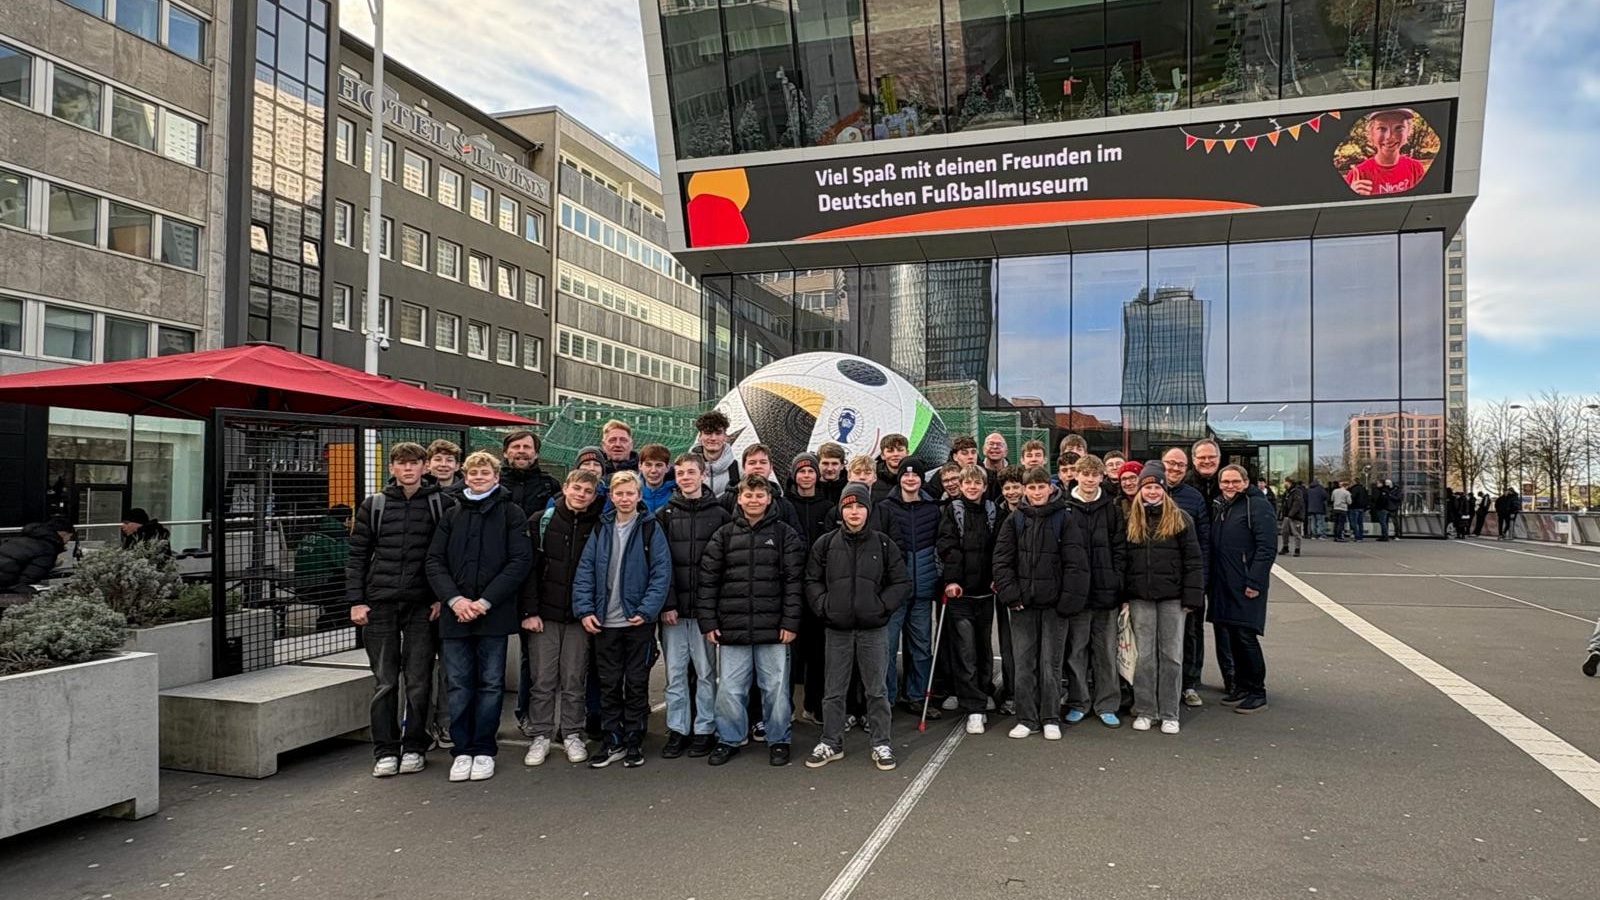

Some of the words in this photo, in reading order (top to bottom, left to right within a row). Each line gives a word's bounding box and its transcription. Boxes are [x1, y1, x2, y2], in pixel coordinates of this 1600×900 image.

[336, 72, 451, 152] HOTEL
[815, 167, 848, 186] Viel
[852, 163, 897, 187] Spaß
[901, 160, 931, 179] mit
[935, 157, 997, 176] deinen
[1002, 147, 1092, 171] Freunden
[1097, 144, 1122, 162] im
[818, 188, 916, 212] Deutschen
[921, 176, 1089, 204] Fußballmuseum
